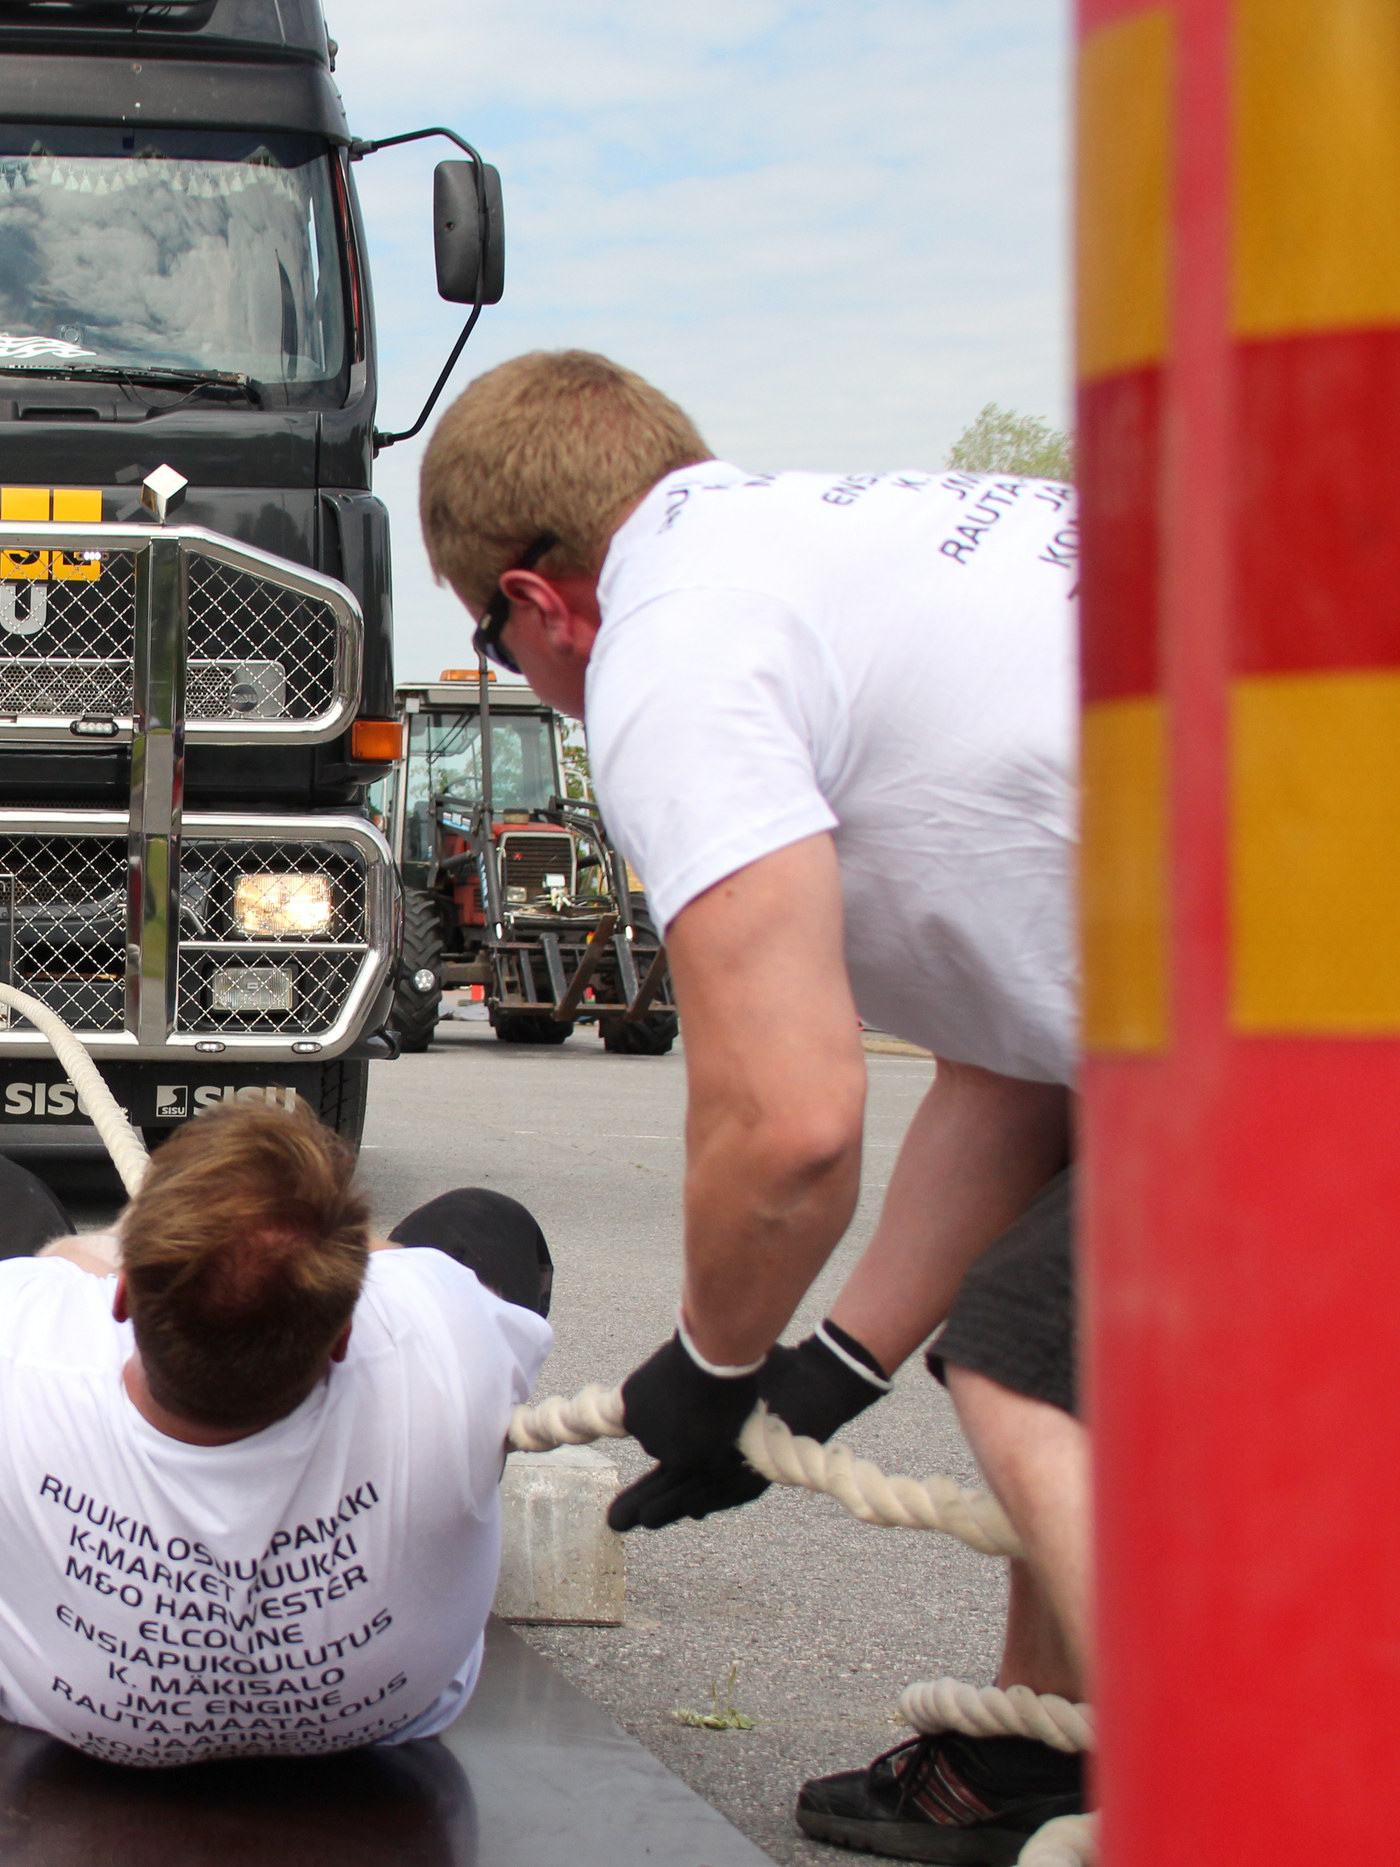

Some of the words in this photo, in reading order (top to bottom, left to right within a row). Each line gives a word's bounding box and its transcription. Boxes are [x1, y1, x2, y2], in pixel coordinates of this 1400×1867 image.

[161, 1106, 185, 1115] SISU
[40, 1473, 159, 1551] RUUKIN
[167, 1481, 379, 1581] OSUUPANKKI
[70, 1524, 235, 1602] K-MARKET
[65, 1555, 143, 1607] M&O
[155, 1564, 368, 1631] HARWESTER
[56, 1603, 393, 1675] ENSIAPUKOULUTUS
[138, 1620, 304, 1655] ELCOLINE
[109, 1660, 137, 1688] K.
[150, 1667, 345, 1695] MÄKISALO
[52, 1671, 407, 1734] RAUTA-MAATALOUS
[116, 1692, 193, 1716] JMC
[204, 1689, 342, 1714] ENGINE
[144, 1727, 326, 1748] JAATINEN
